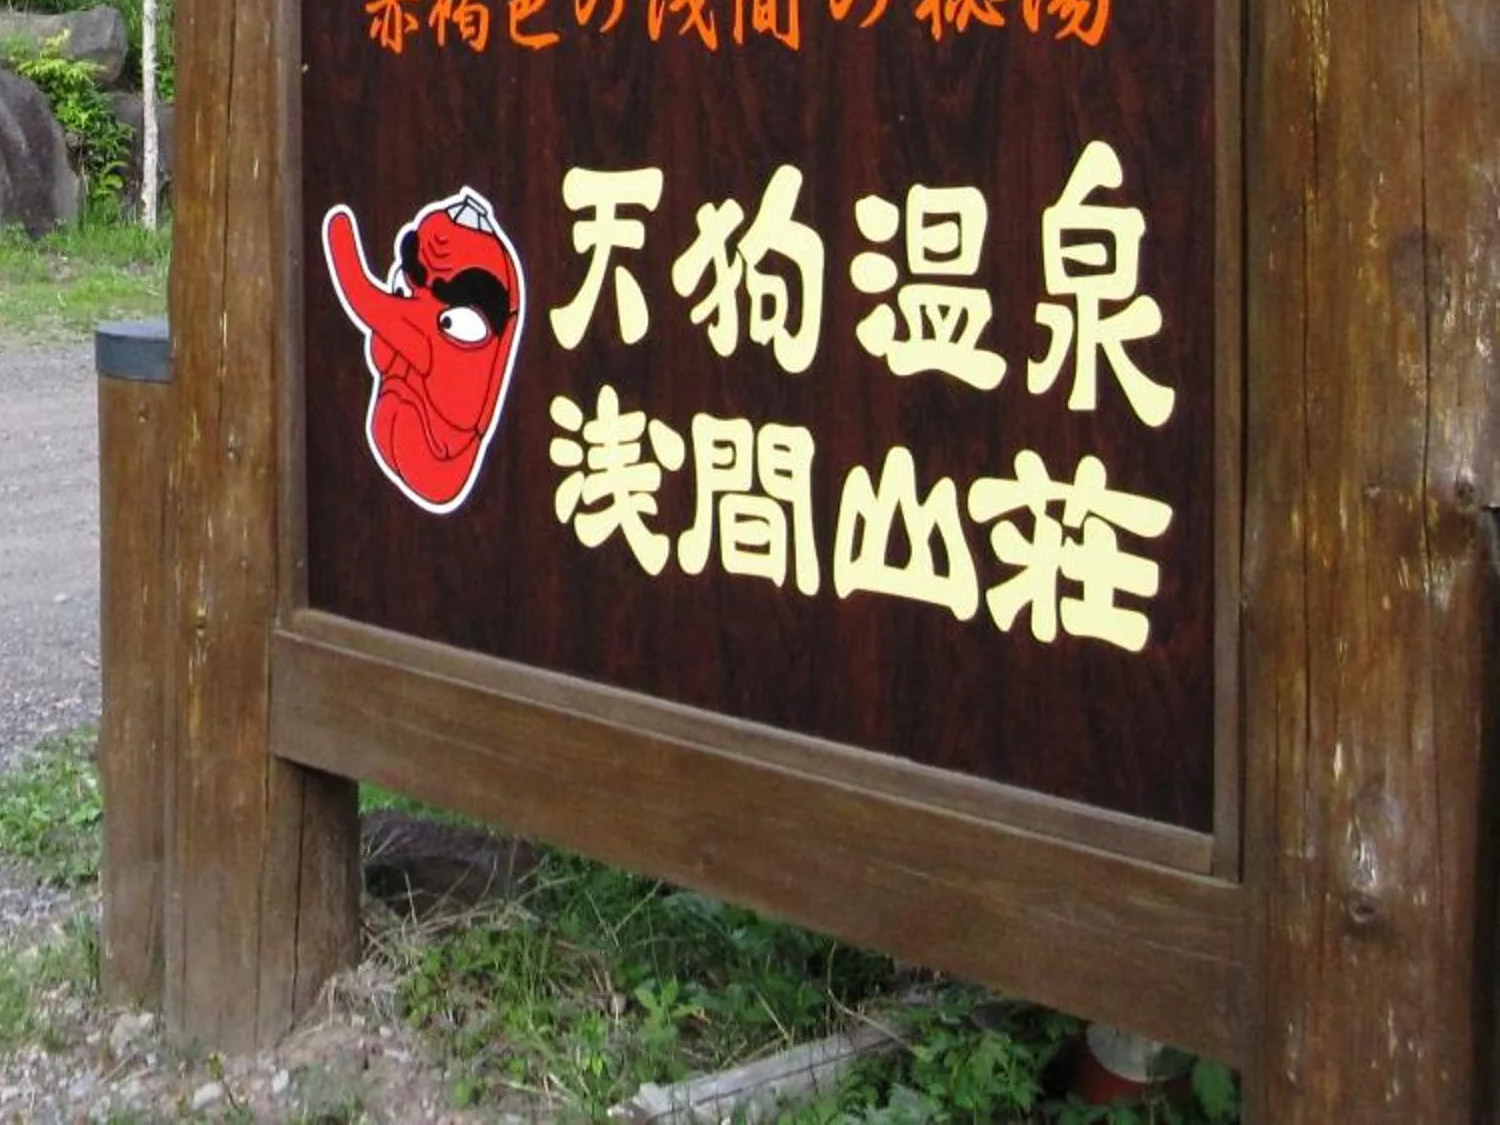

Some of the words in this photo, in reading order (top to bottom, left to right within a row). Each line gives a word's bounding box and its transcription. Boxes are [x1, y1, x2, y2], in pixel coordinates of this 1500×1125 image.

[549, 140, 1174, 427] 天狗温泉
[549, 384, 1173, 652] 浅間山荘
